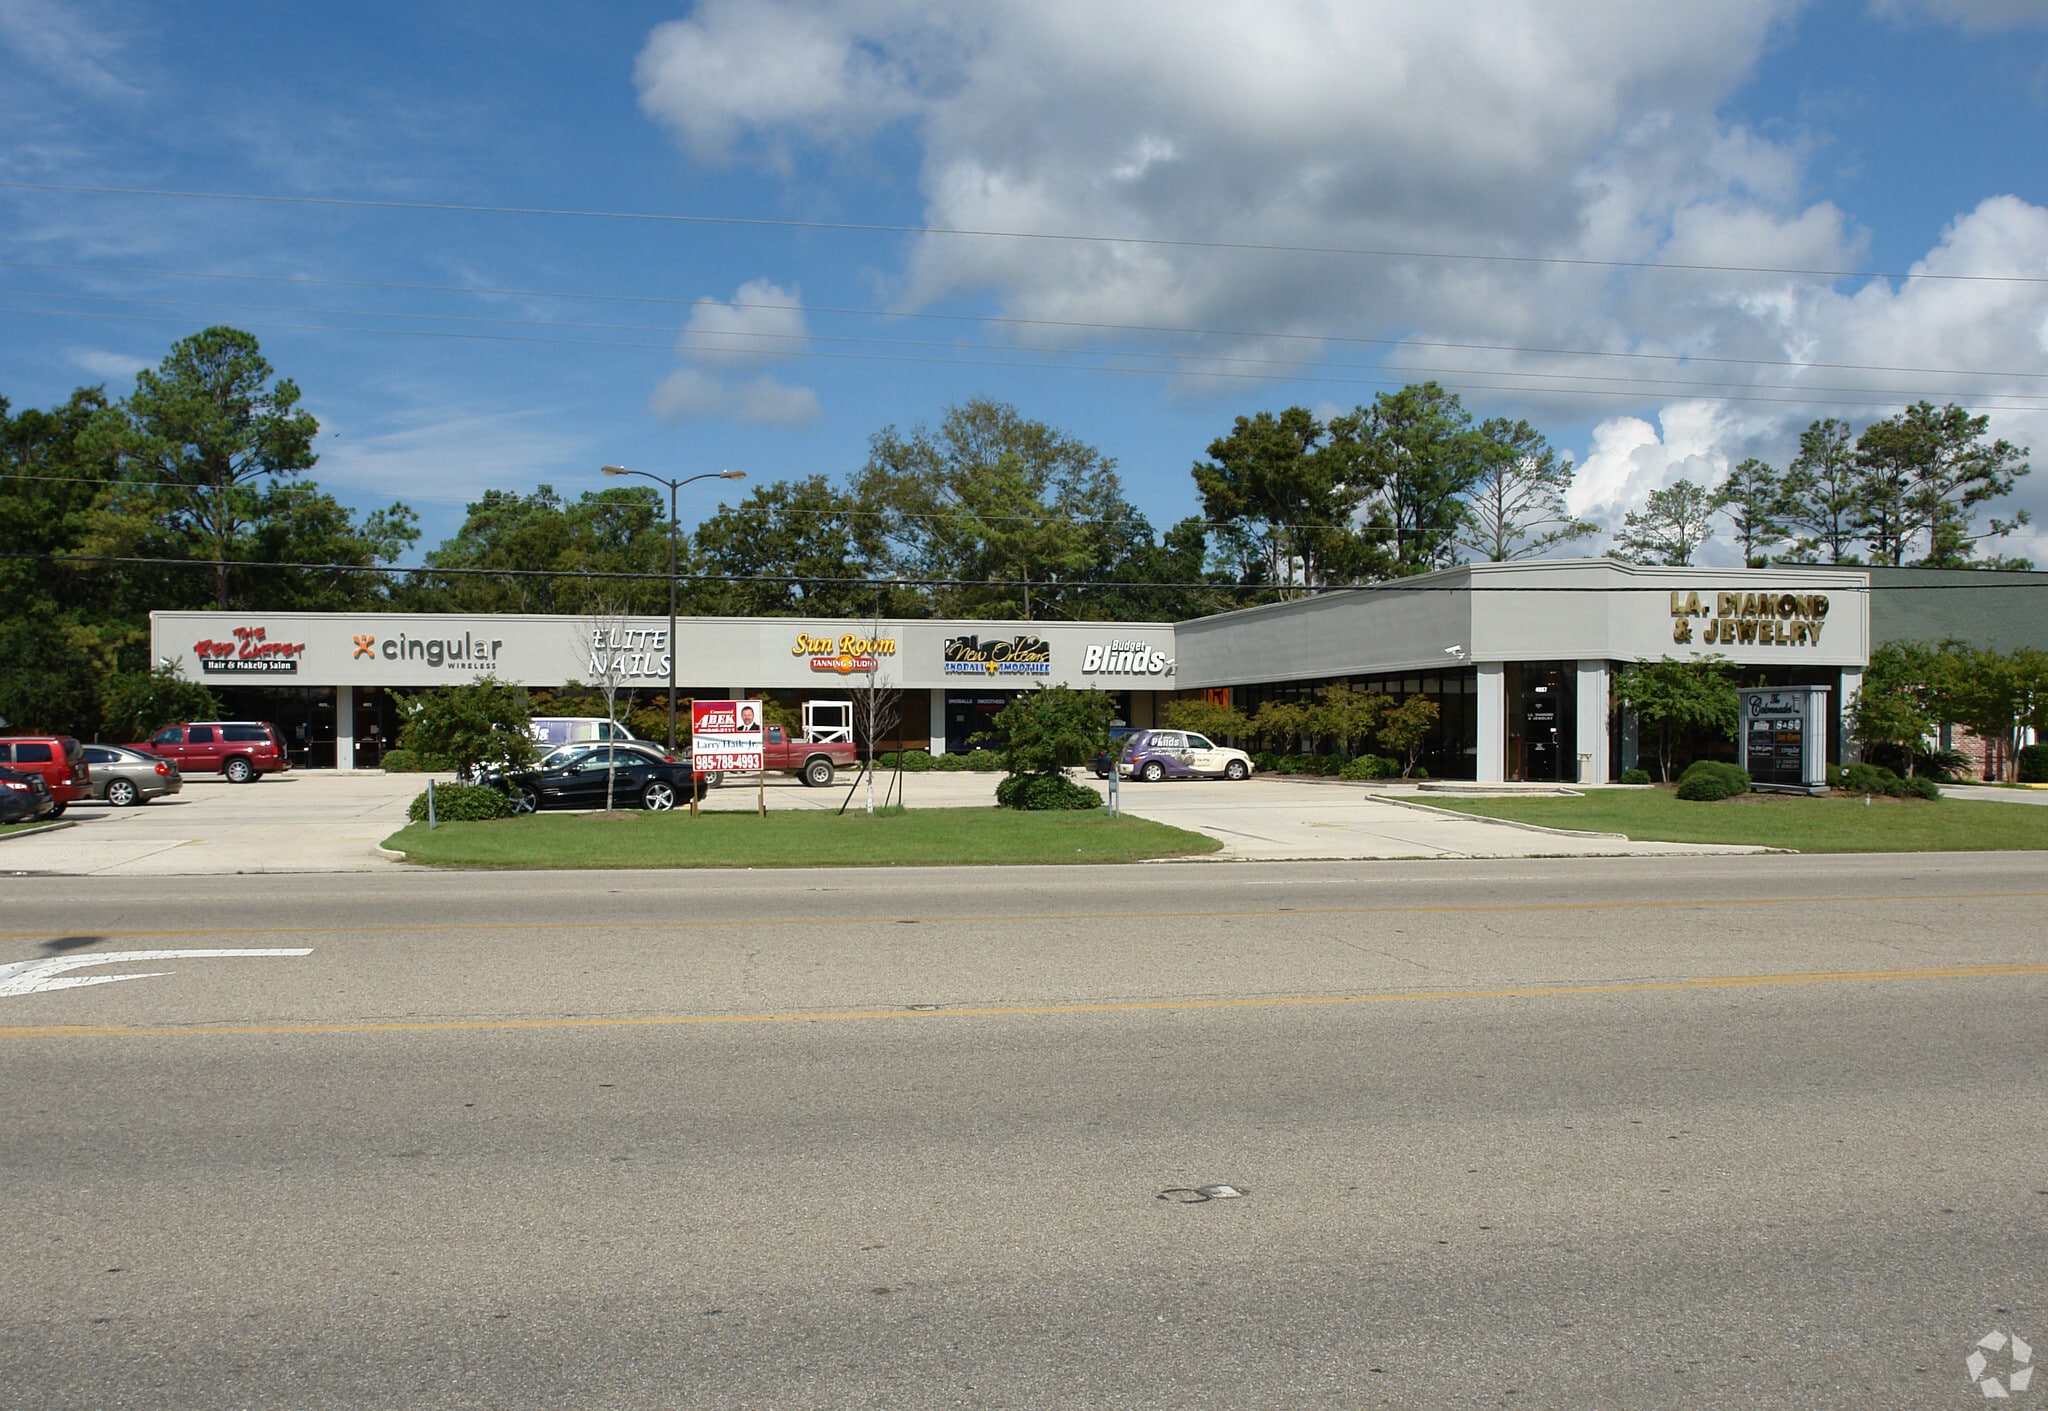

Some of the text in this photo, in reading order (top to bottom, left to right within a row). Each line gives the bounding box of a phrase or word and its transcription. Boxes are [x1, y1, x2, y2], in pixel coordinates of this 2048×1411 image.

[1717, 592, 1829, 620] DIAMOND
[232, 626, 266, 641] THE
[593, 628, 667, 651] ELITE
[1673, 617, 1825, 646] & JEWELRY
[193, 639, 305, 661] RED CARPET
[382, 631, 502, 667] cingular
[791, 633, 896, 657] Sun Room
[1111, 639, 1145, 652] Budget
[208, 661, 226, 669] Hair
[227, 661, 235, 669] &
[269, 661, 291, 669] Salon
[447, 662, 497, 670] WIRELESS
[588, 652, 671, 677] NAILS
[812, 660, 846, 668] TANNING
[1082, 645, 1166, 674] Blinds
[696, 754, 759, 770] 985-788-4993
